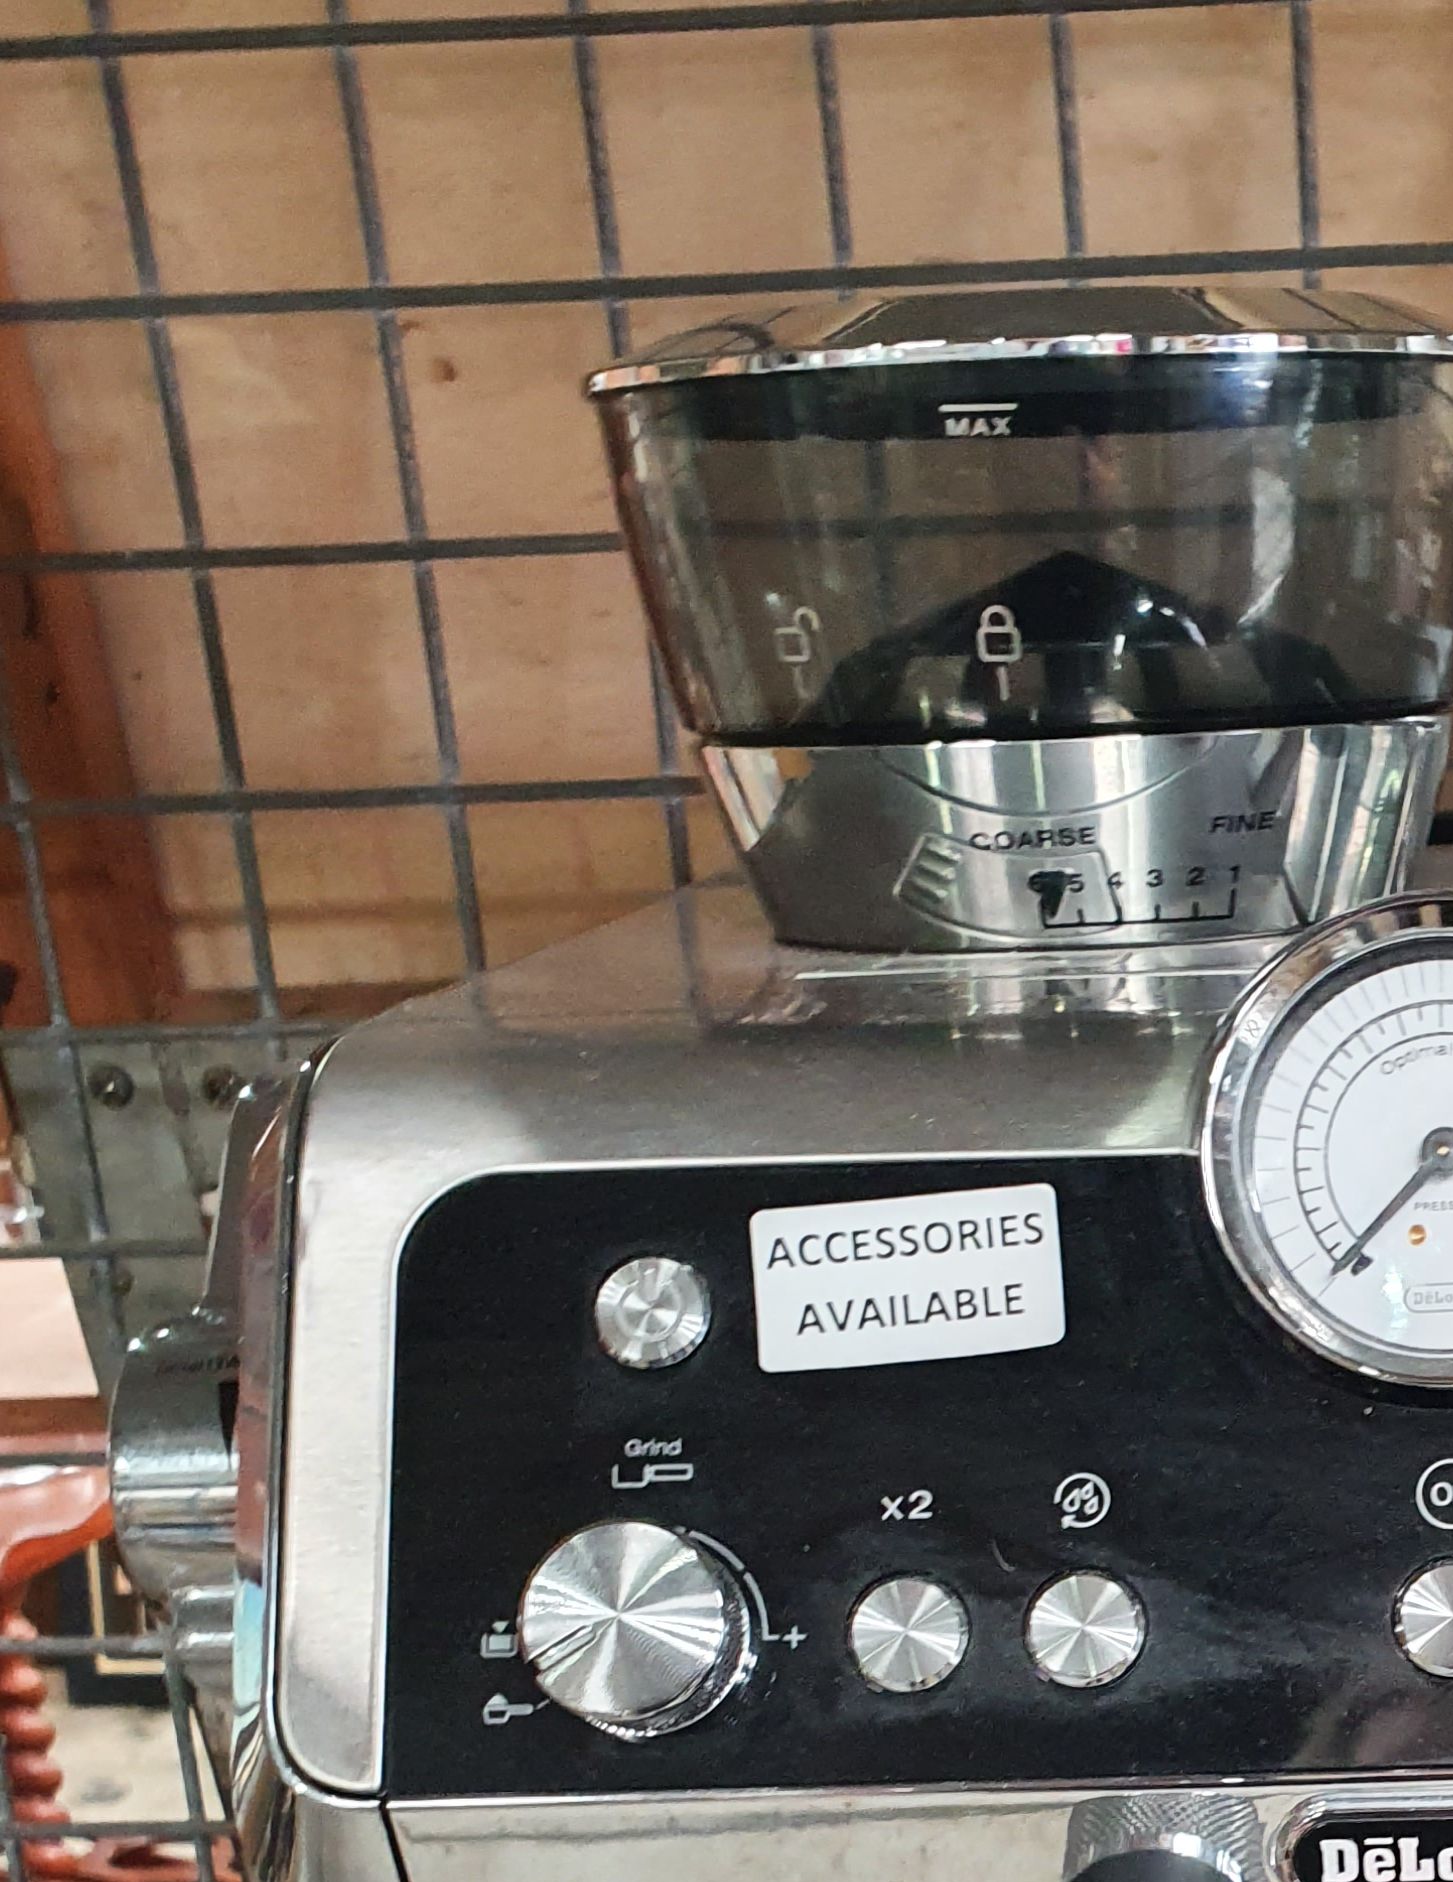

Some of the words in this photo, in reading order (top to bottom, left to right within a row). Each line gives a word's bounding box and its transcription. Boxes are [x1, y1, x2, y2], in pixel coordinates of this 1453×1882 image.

[945, 416, 1012, 437] MAX
[1208, 811, 1277, 833] FINE
[969, 826, 1096, 850] COARSE
[1067, 873, 1084, 893] 5
[1146, 868, 1163, 887] 3
[1189, 866, 1206, 886] 2
[1231, 864, 1241, 884] 1
[767, 1212, 1044, 1269] ACCESSORIES
[797, 1283, 1026, 1335] AVAILABLE
[624, 1437, 683, 1457] Grind
[880, 1489, 934, 1521] x2
